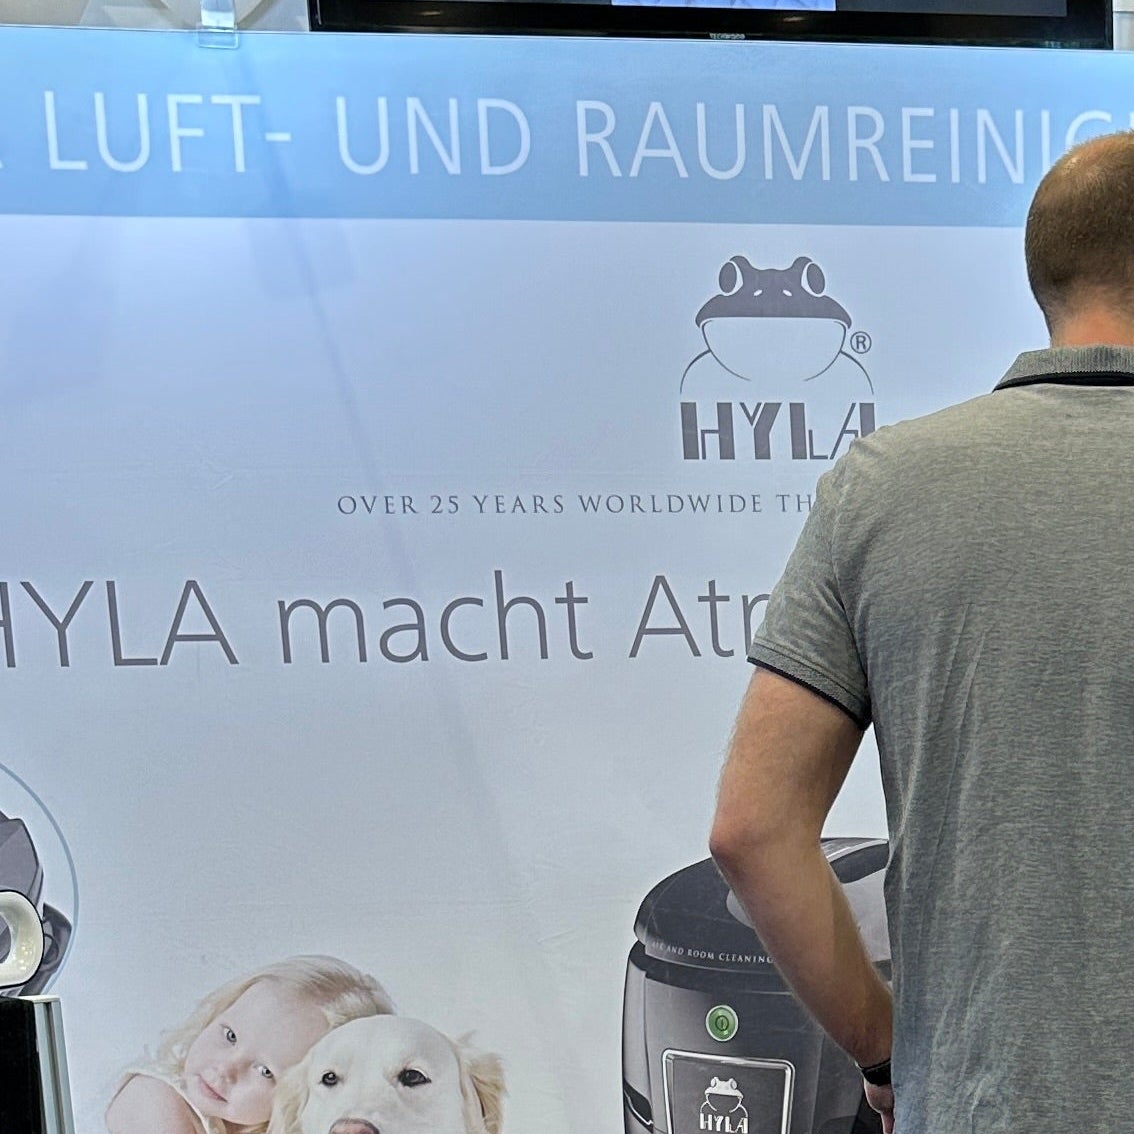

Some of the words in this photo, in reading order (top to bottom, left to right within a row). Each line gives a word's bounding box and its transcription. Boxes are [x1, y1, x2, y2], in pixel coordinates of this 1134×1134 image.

[44, 90, 292, 173] LUFT-
[335, 96, 531, 175] UND
[680, 402, 876, 460] HYLA
[337, 494, 419, 515] OVER
[430, 494, 459, 514] 25
[472, 494, 564, 514] YEARS
[577, 494, 763, 514] WORLDWIDE
[277, 569, 594, 664] macht
[666, 945, 684, 956] AND
[687, 948, 715, 960] ROOM
[700, 1113, 749, 1134] HYLA
